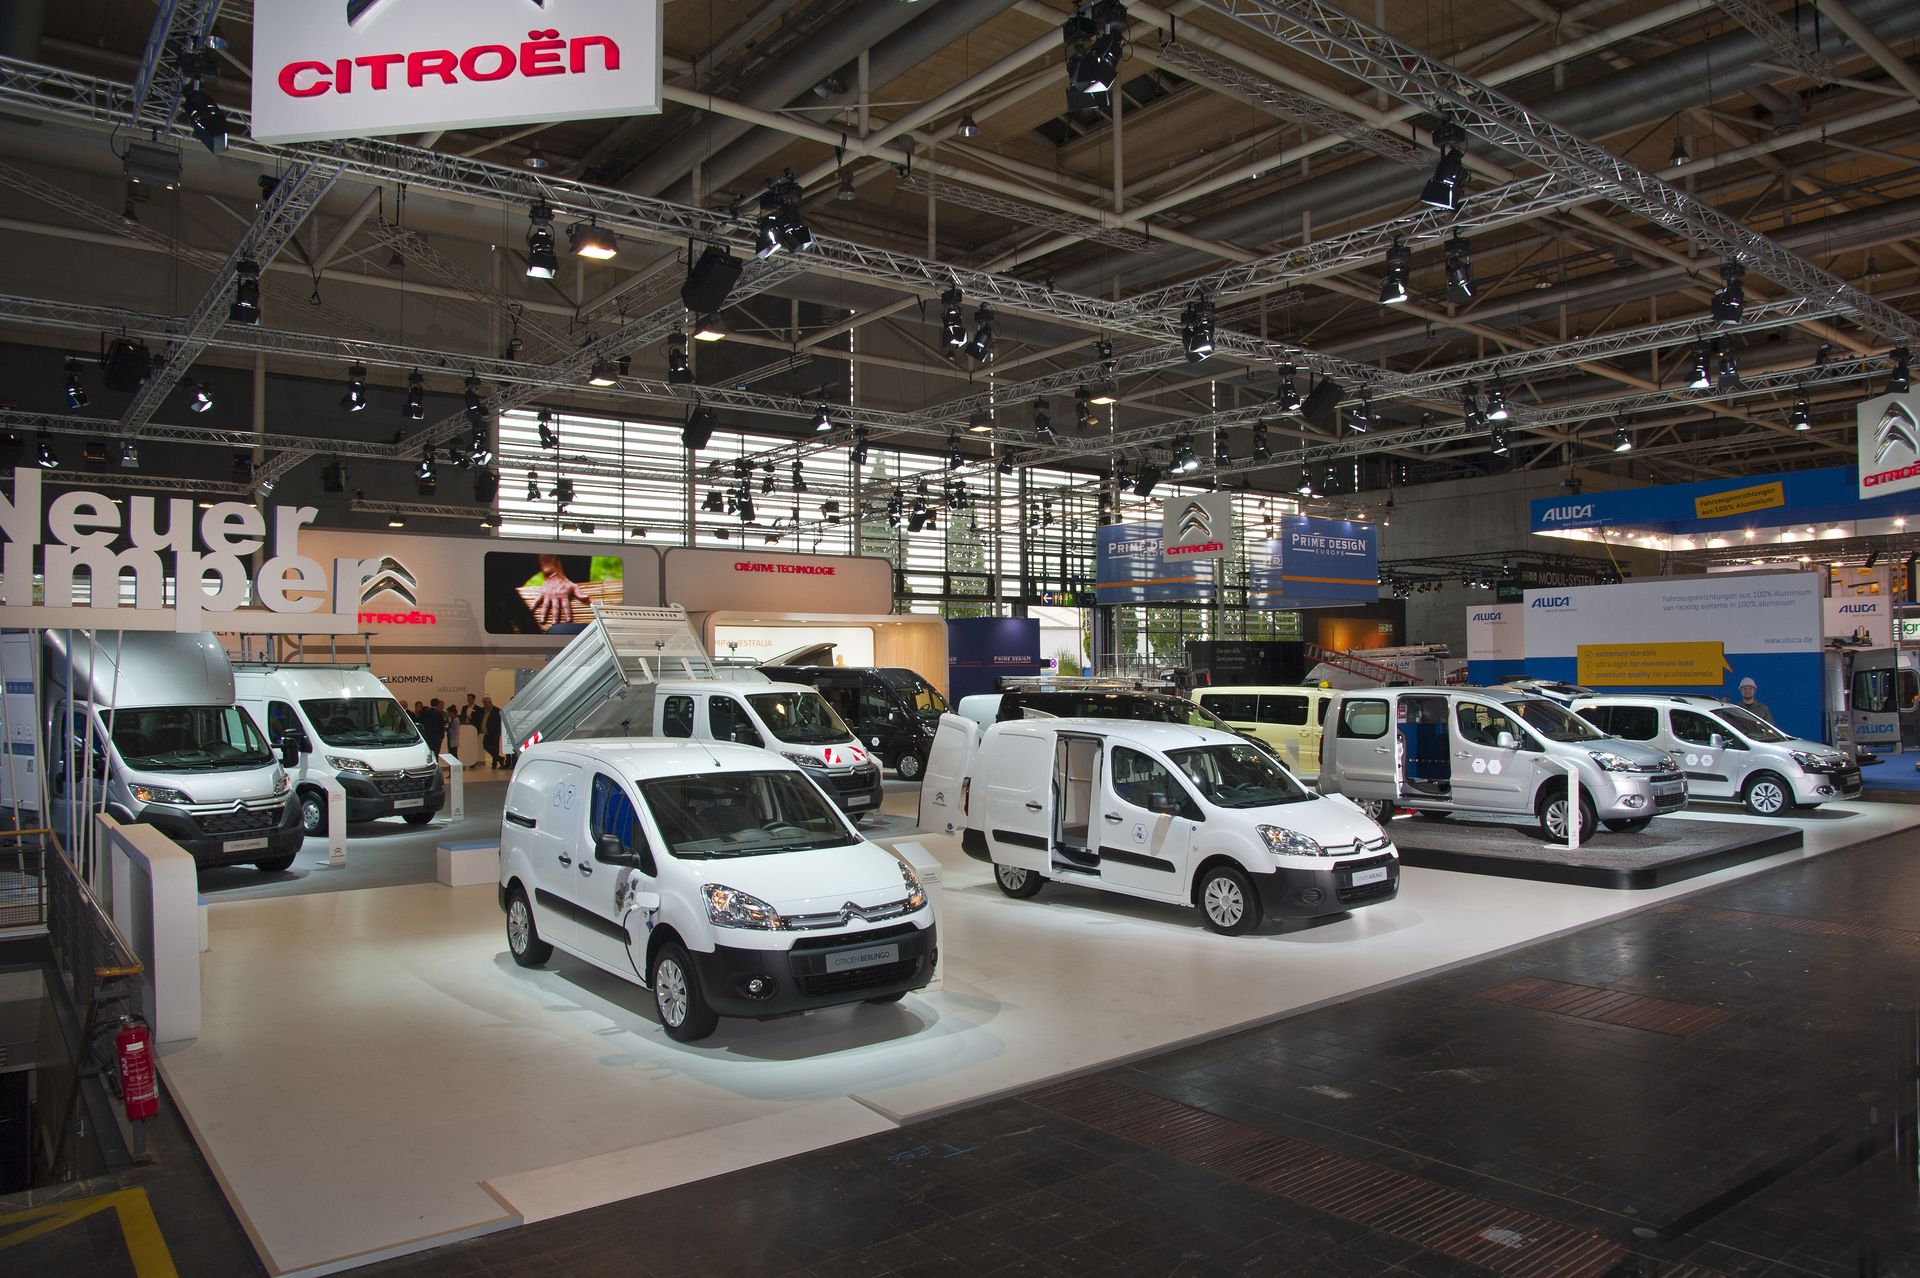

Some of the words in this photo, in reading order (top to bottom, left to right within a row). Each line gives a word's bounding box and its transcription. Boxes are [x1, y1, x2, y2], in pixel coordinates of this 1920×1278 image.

[278, 28, 620, 98] CITROËN
[1862, 460, 1920, 487] CITROË
[1700, 487, 1776, 506] Fahrzeugeinrichtungen
[1715, 504, 1735, 513] 100%
[1736, 497, 1774, 508] Aluminium
[1541, 504, 1593, 522] ALUCA
[1108, 540, 1145, 554] PRIME
[1167, 541, 1223, 555] CITROËN
[1292, 533, 1325, 548] PRIME
[1329, 538, 1366, 551] DESIGN
[1314, 547, 1345, 557] EUROPE
[735, 561, 775, 573] CRÉATIVE
[776, 564, 836, 575] TECHNOLOGIE
[1538, 571, 1595, 587] MODUL-SYSTEM
[1531, 596, 1570, 608] ALUCA
[1662, 592, 1737, 603] Fahrzeugeinrichtungen
[1774, 589, 1812, 597] Aluminium
[1675, 603, 1699, 611] racking
[1700, 602, 1728, 610] systems
[1838, 603, 1877, 614] ALUCA
[358, 611, 436, 624] ITROËN
[1472, 612, 1501, 621] ALUCA
[1764, 636, 1813, 644] www.aluca.de
[1595, 650, 1629, 658] extremely
[1614, 661, 1628, 669] light
[1628, 671, 1650, 679] quality
[1664, 670, 1713, 678] professionals
[1856, 723, 1895, 735] ALUCA
[860, 950, 890, 963] BERLINGO
